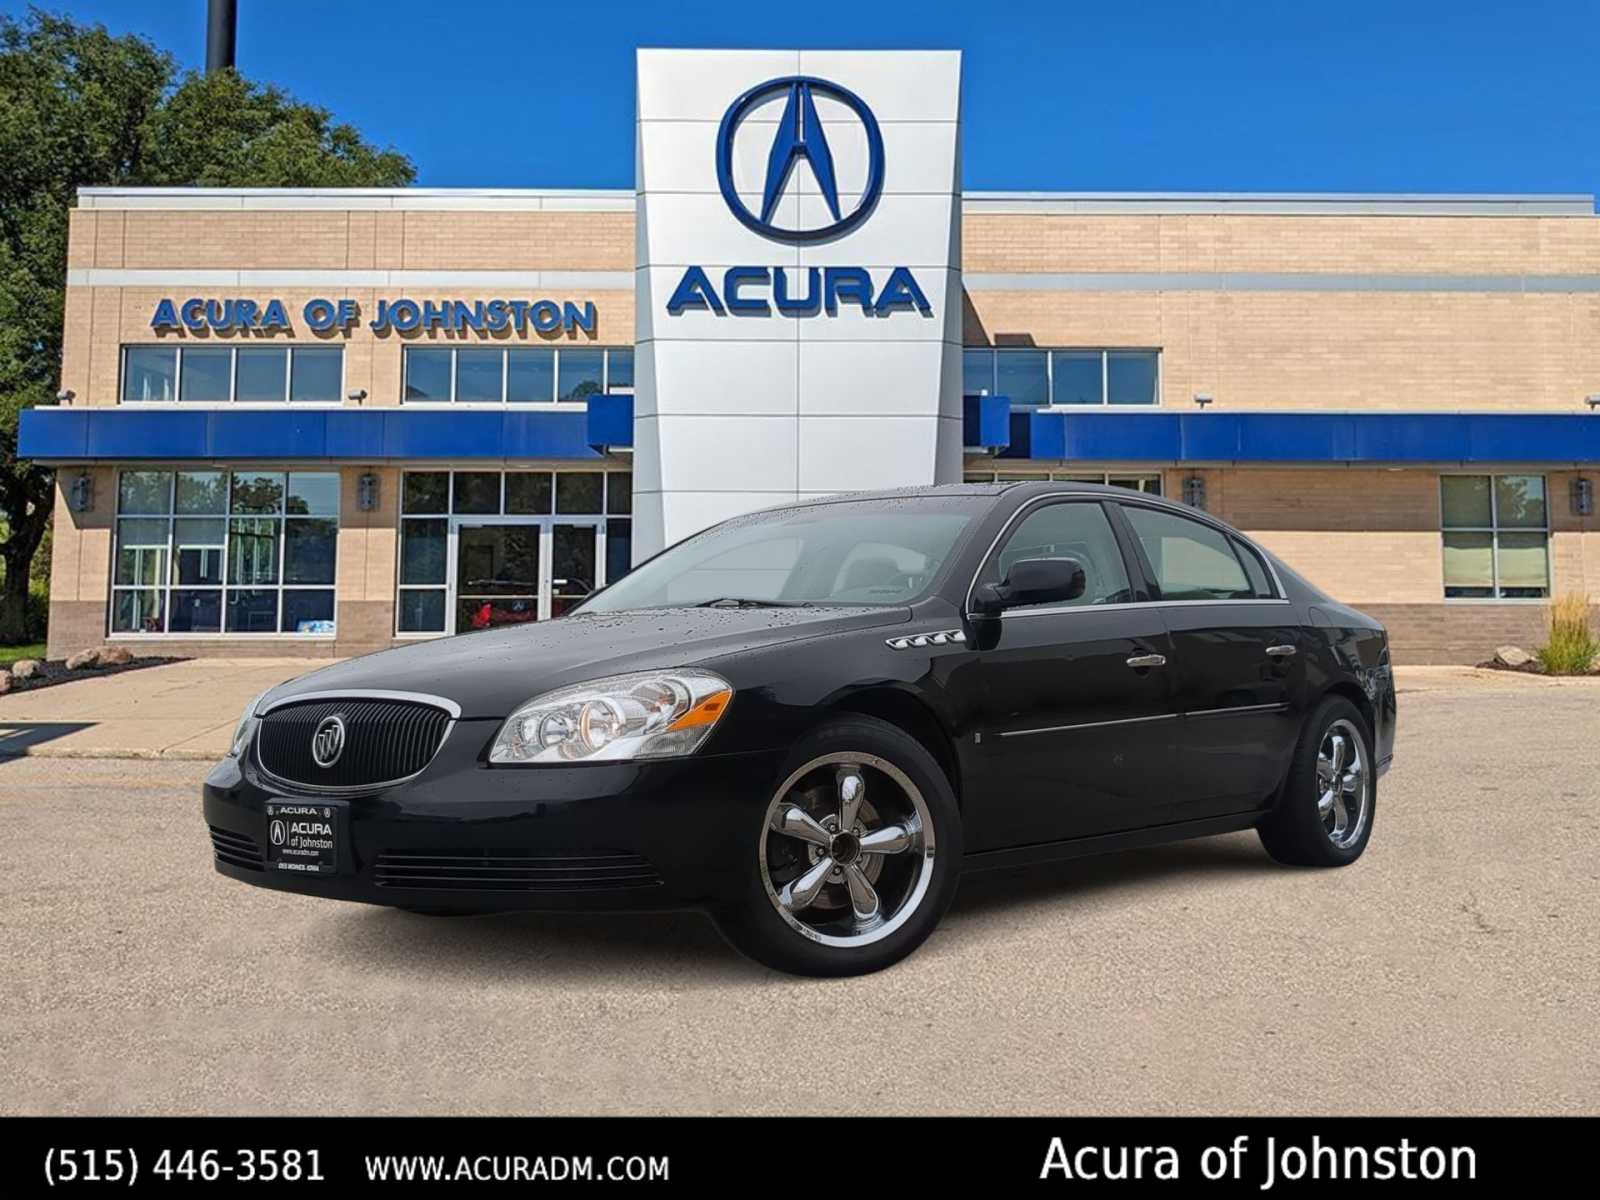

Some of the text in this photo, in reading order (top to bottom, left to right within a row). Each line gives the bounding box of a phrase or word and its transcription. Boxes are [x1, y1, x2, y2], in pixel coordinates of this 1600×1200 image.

[666, 265, 934, 317] ACURA
[150, 298, 596, 332] ACURA OF JOHNSTON
[280, 806, 318, 815] ACURA
[291, 822, 332, 835] ACURA
[290, 836, 299, 847] of
